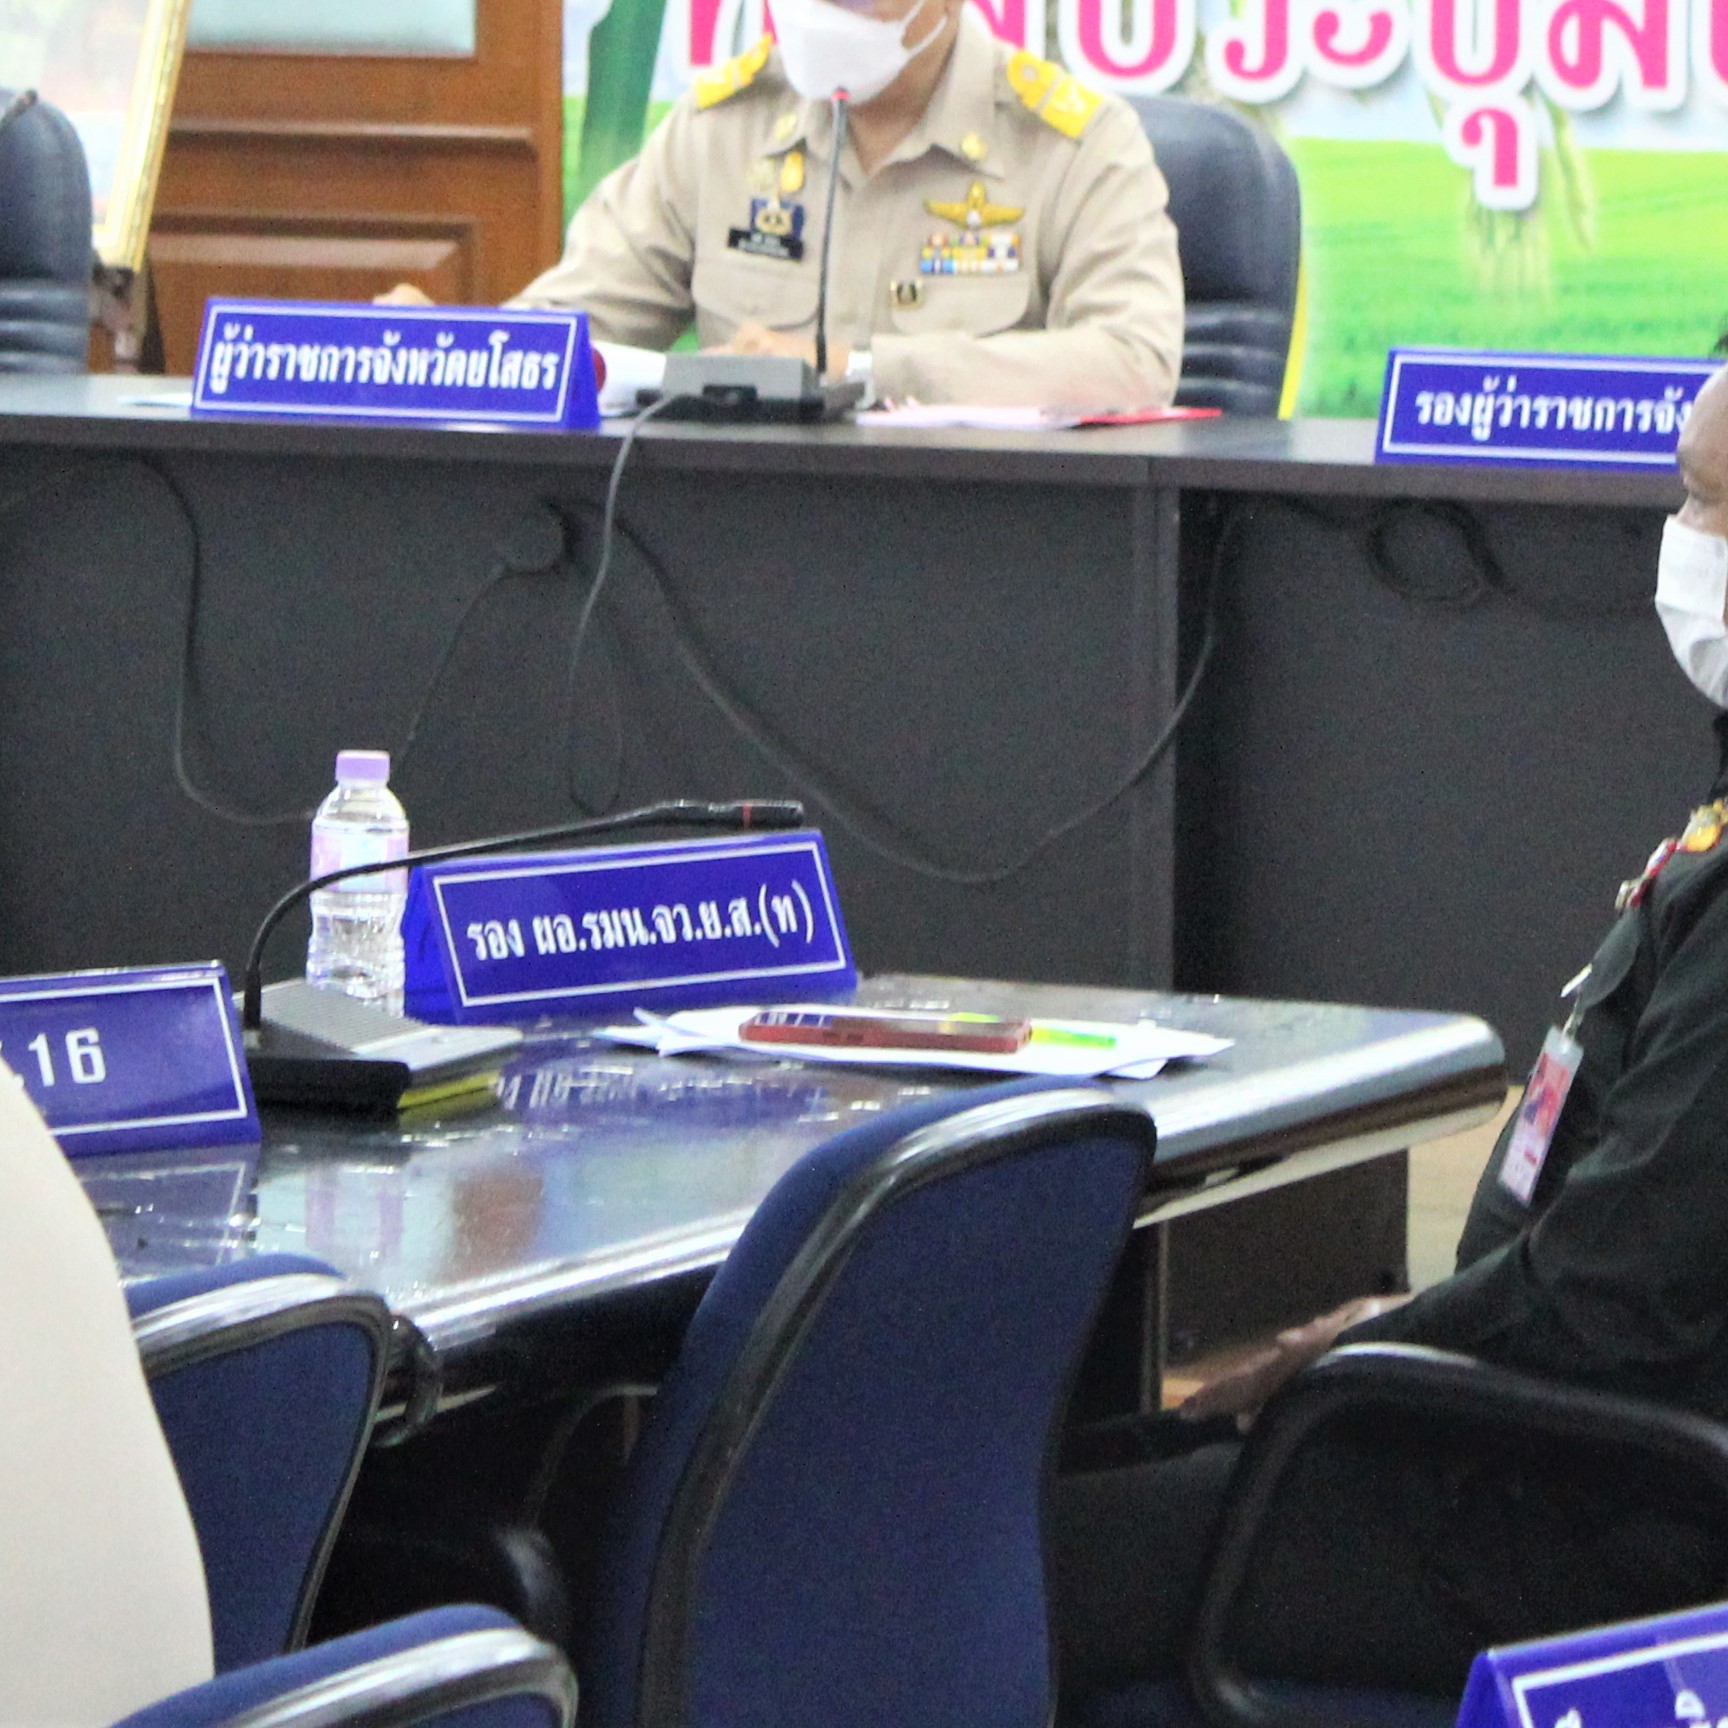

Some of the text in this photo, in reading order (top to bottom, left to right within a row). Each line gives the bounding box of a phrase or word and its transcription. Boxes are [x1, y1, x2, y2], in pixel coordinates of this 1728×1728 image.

[209, 322, 561, 395] ผู้ว่าราชการจังหวัดยโสธร
[1415, 374, 1693, 442] รองผู้ว่าราชการจัง
[466, 878, 816, 962] รอง ผอ.รมน.จว.ย.ส.(ท)
